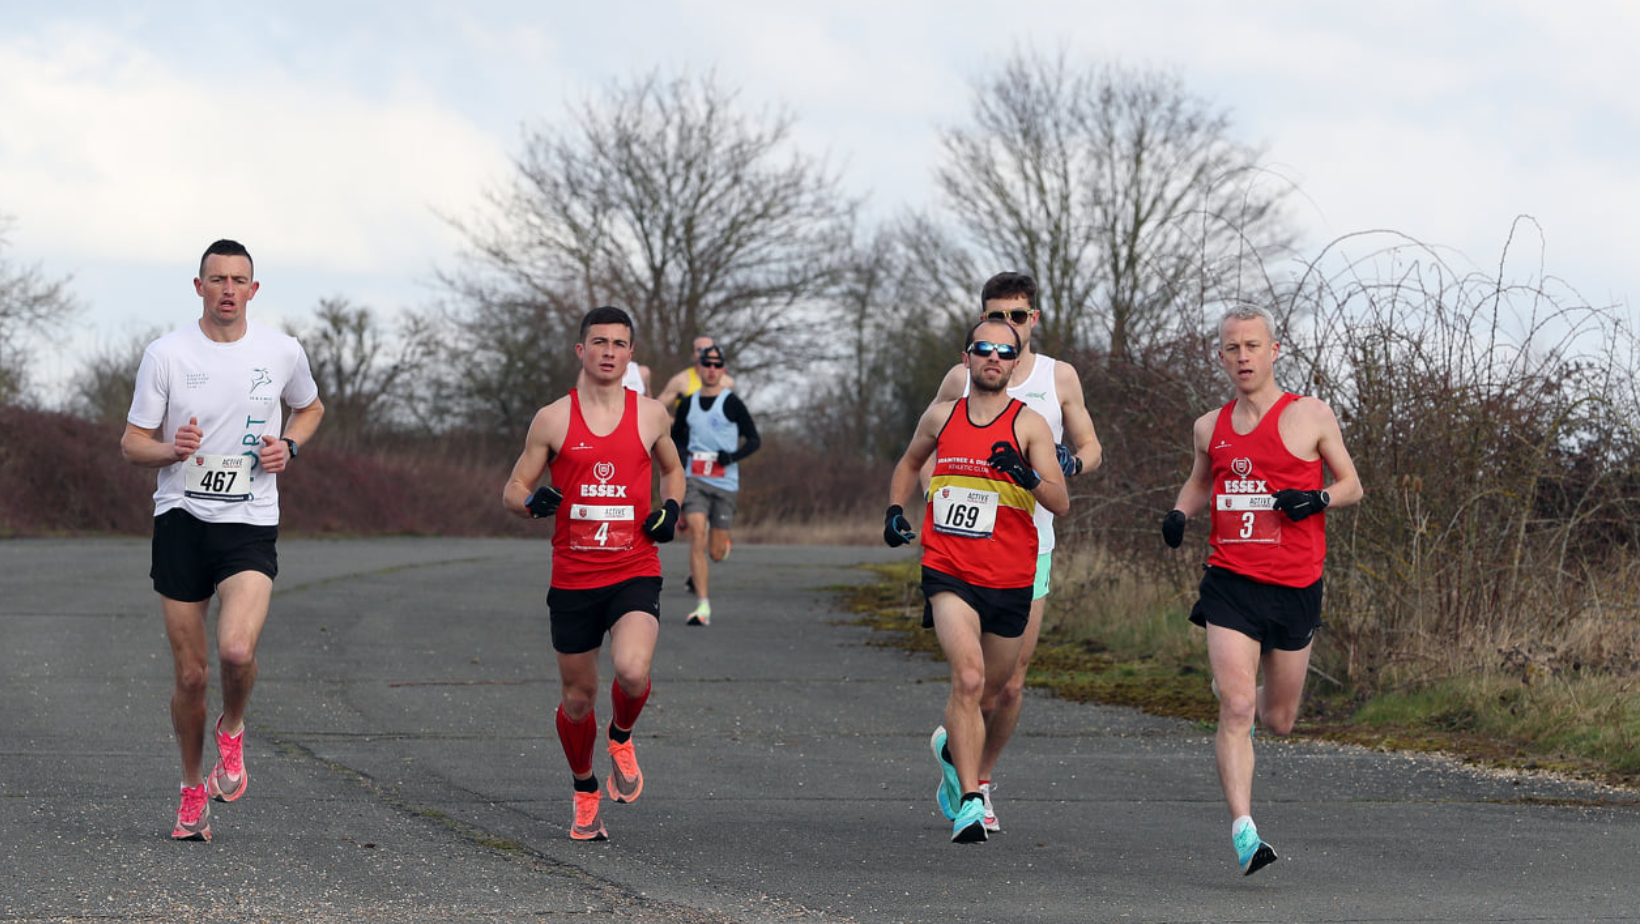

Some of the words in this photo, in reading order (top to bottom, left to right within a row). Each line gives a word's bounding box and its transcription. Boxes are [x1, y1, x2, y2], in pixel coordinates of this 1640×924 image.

[200, 470, 238, 493] 467
[1224, 480, 1268, 493] ESSEX
[581, 484, 627, 498] ESSEX
[967, 492, 989, 502] ACTIVE
[605, 508, 626, 516] ACTIVE
[945, 503, 980, 529] 169
[594, 522, 610, 546] 4
[1240, 511, 1255, 539] 3
